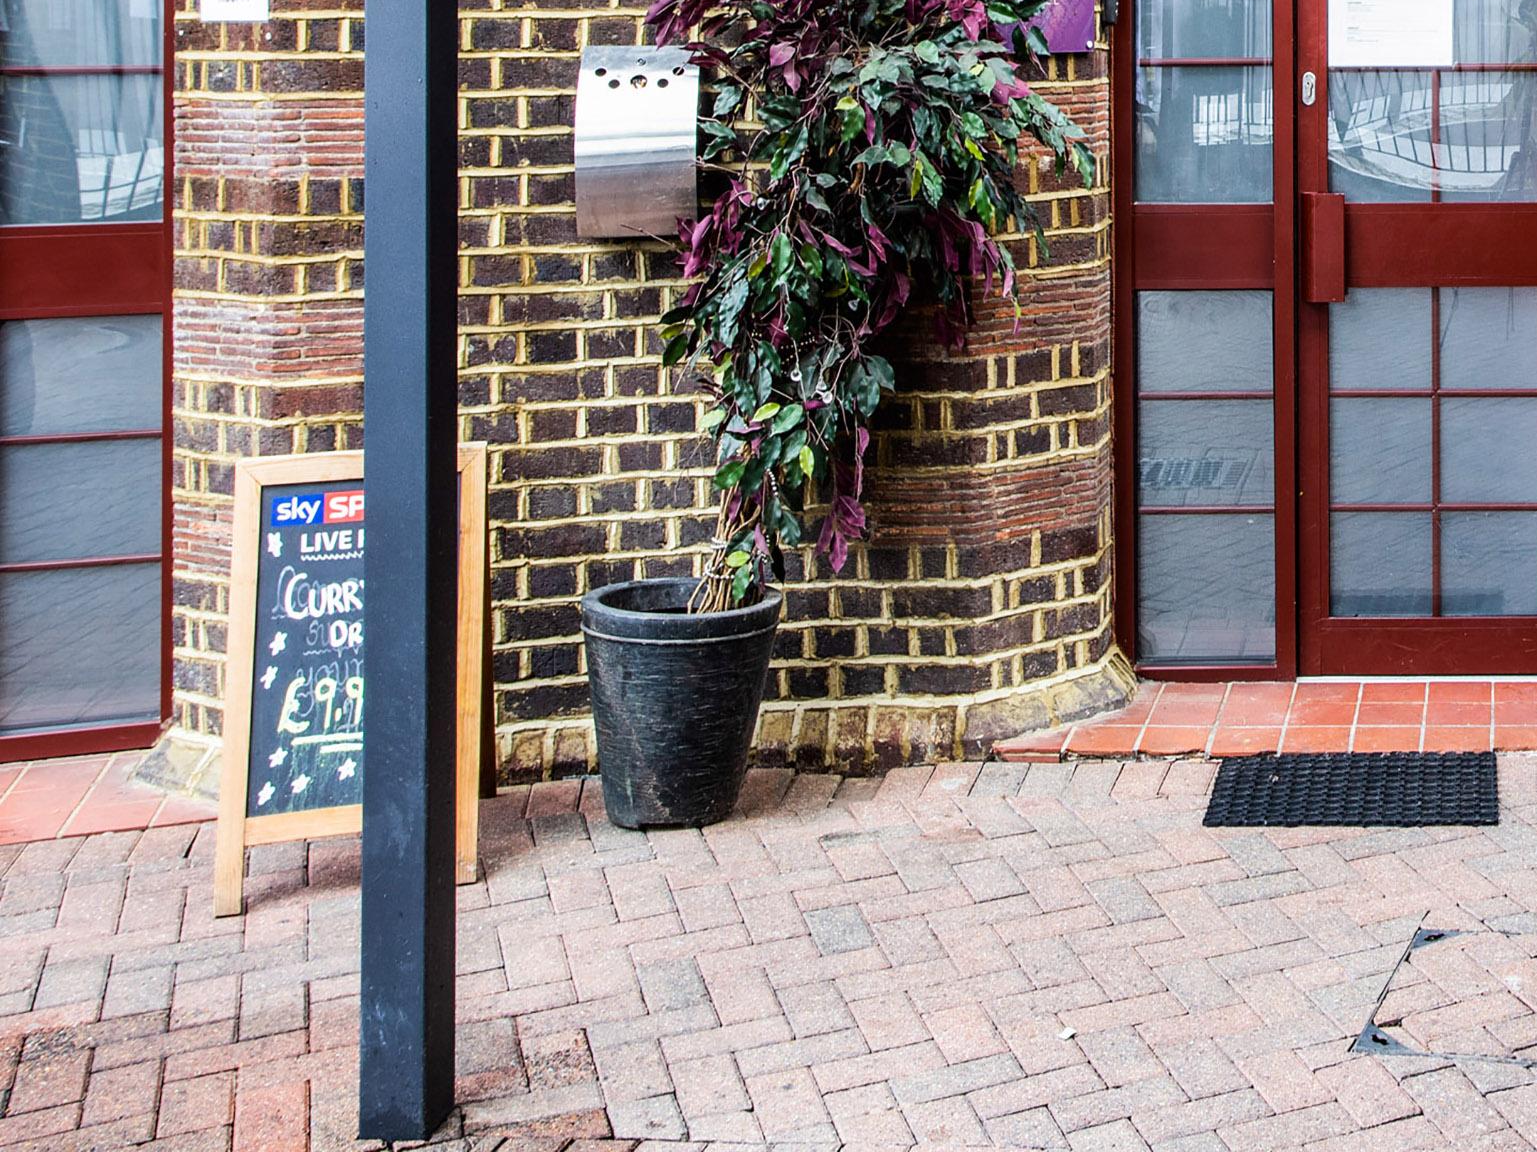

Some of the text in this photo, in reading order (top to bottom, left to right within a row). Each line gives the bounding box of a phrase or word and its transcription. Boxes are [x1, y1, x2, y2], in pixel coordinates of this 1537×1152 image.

[276, 494, 365, 525] sky SP
[300, 529, 353, 554] LIVE
[284, 572, 365, 620] CURR
[277, 676, 365, 734] £9.9
